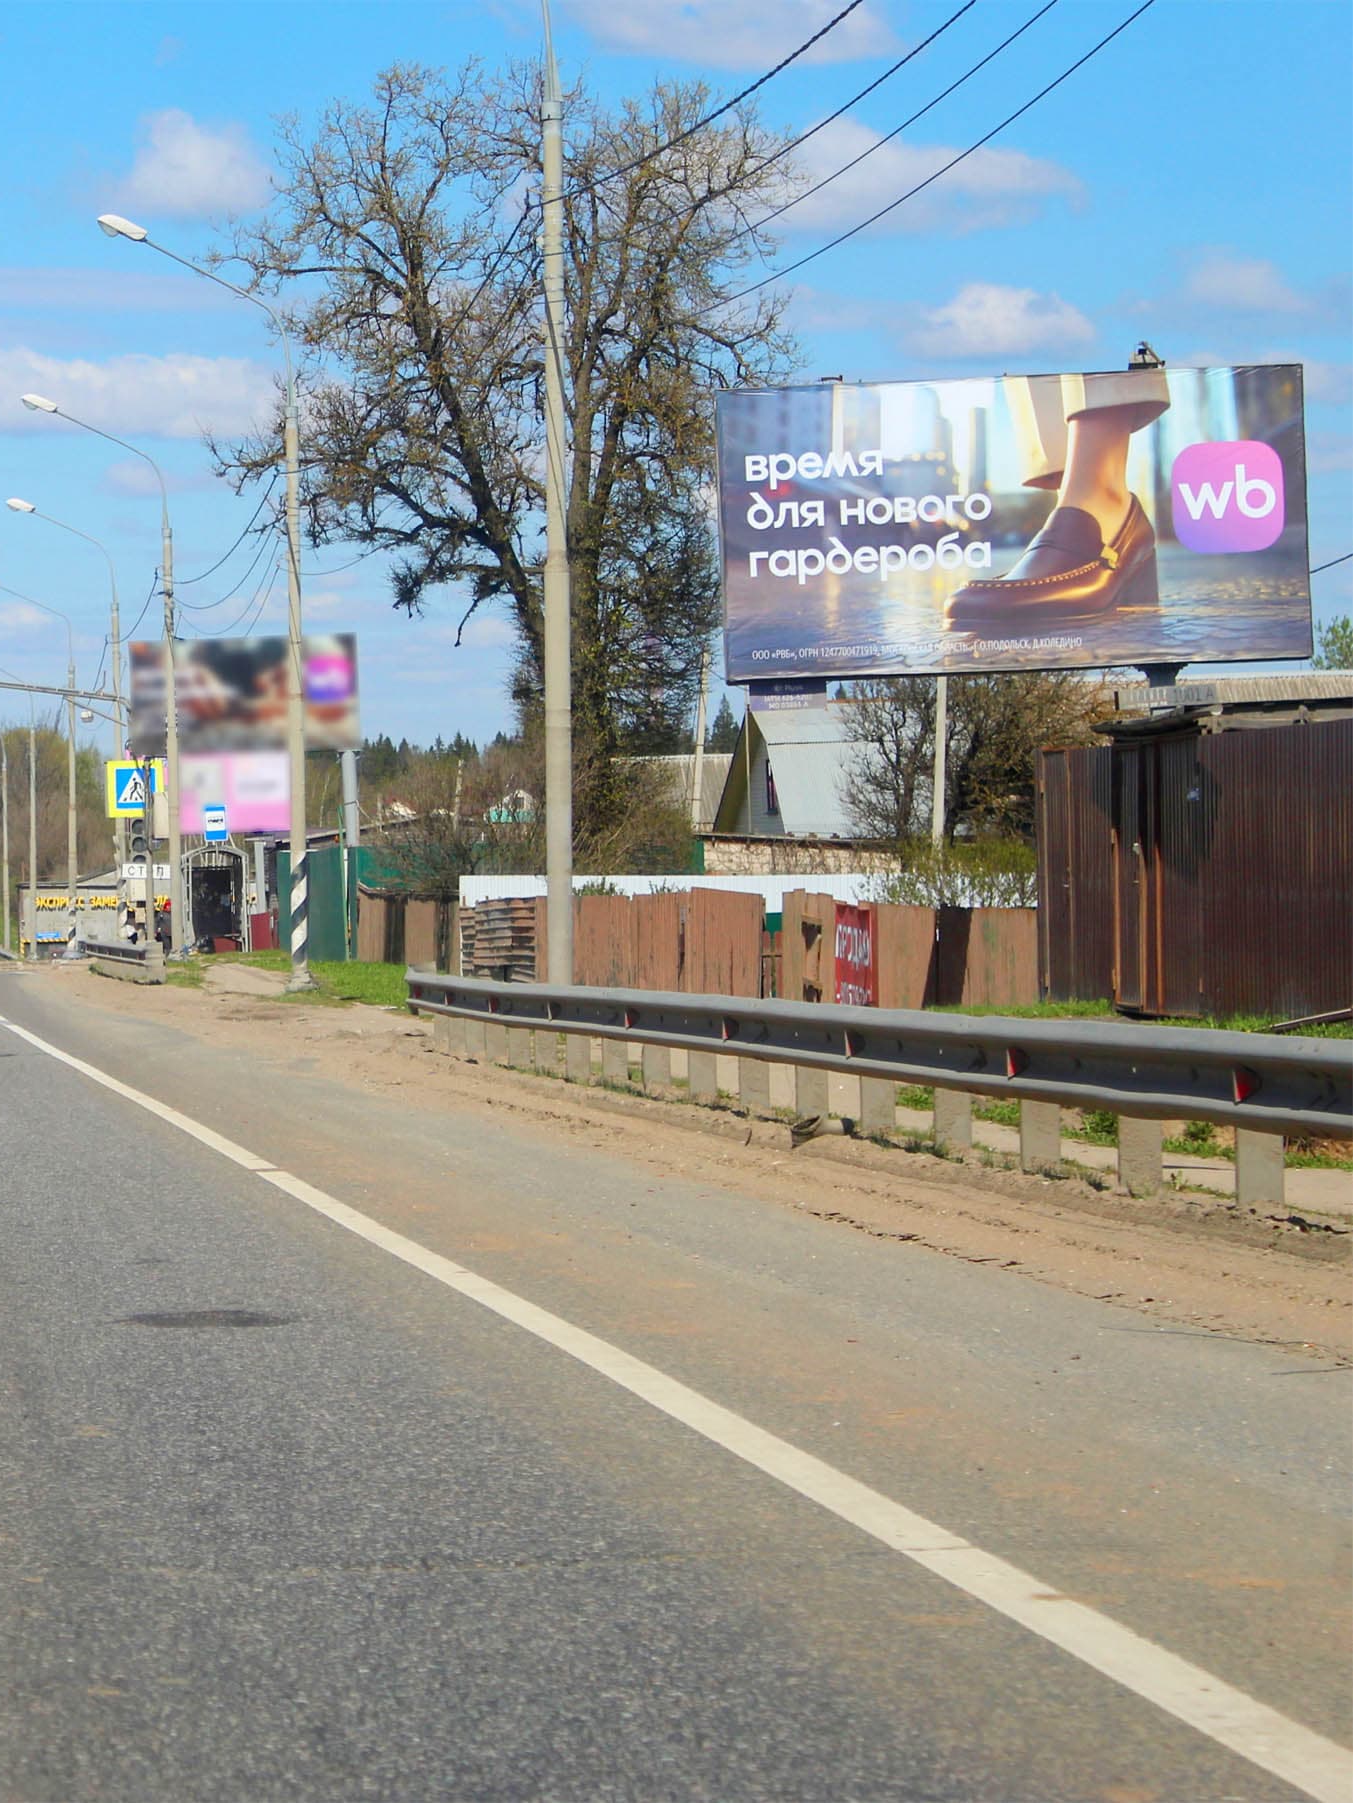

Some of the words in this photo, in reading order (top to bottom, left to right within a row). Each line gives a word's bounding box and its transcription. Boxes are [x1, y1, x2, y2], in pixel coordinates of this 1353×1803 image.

[745, 450, 884, 490] время
[747, 492, 825, 530] для
[840, 493, 993, 526] нового
[1178, 463, 1277, 520] wb
[749, 532, 992, 585] гардероба
[752, 649, 770, 660] ООО
[799, 647, 818, 658] ОГРН
[128, 865, 164, 877] СТП
